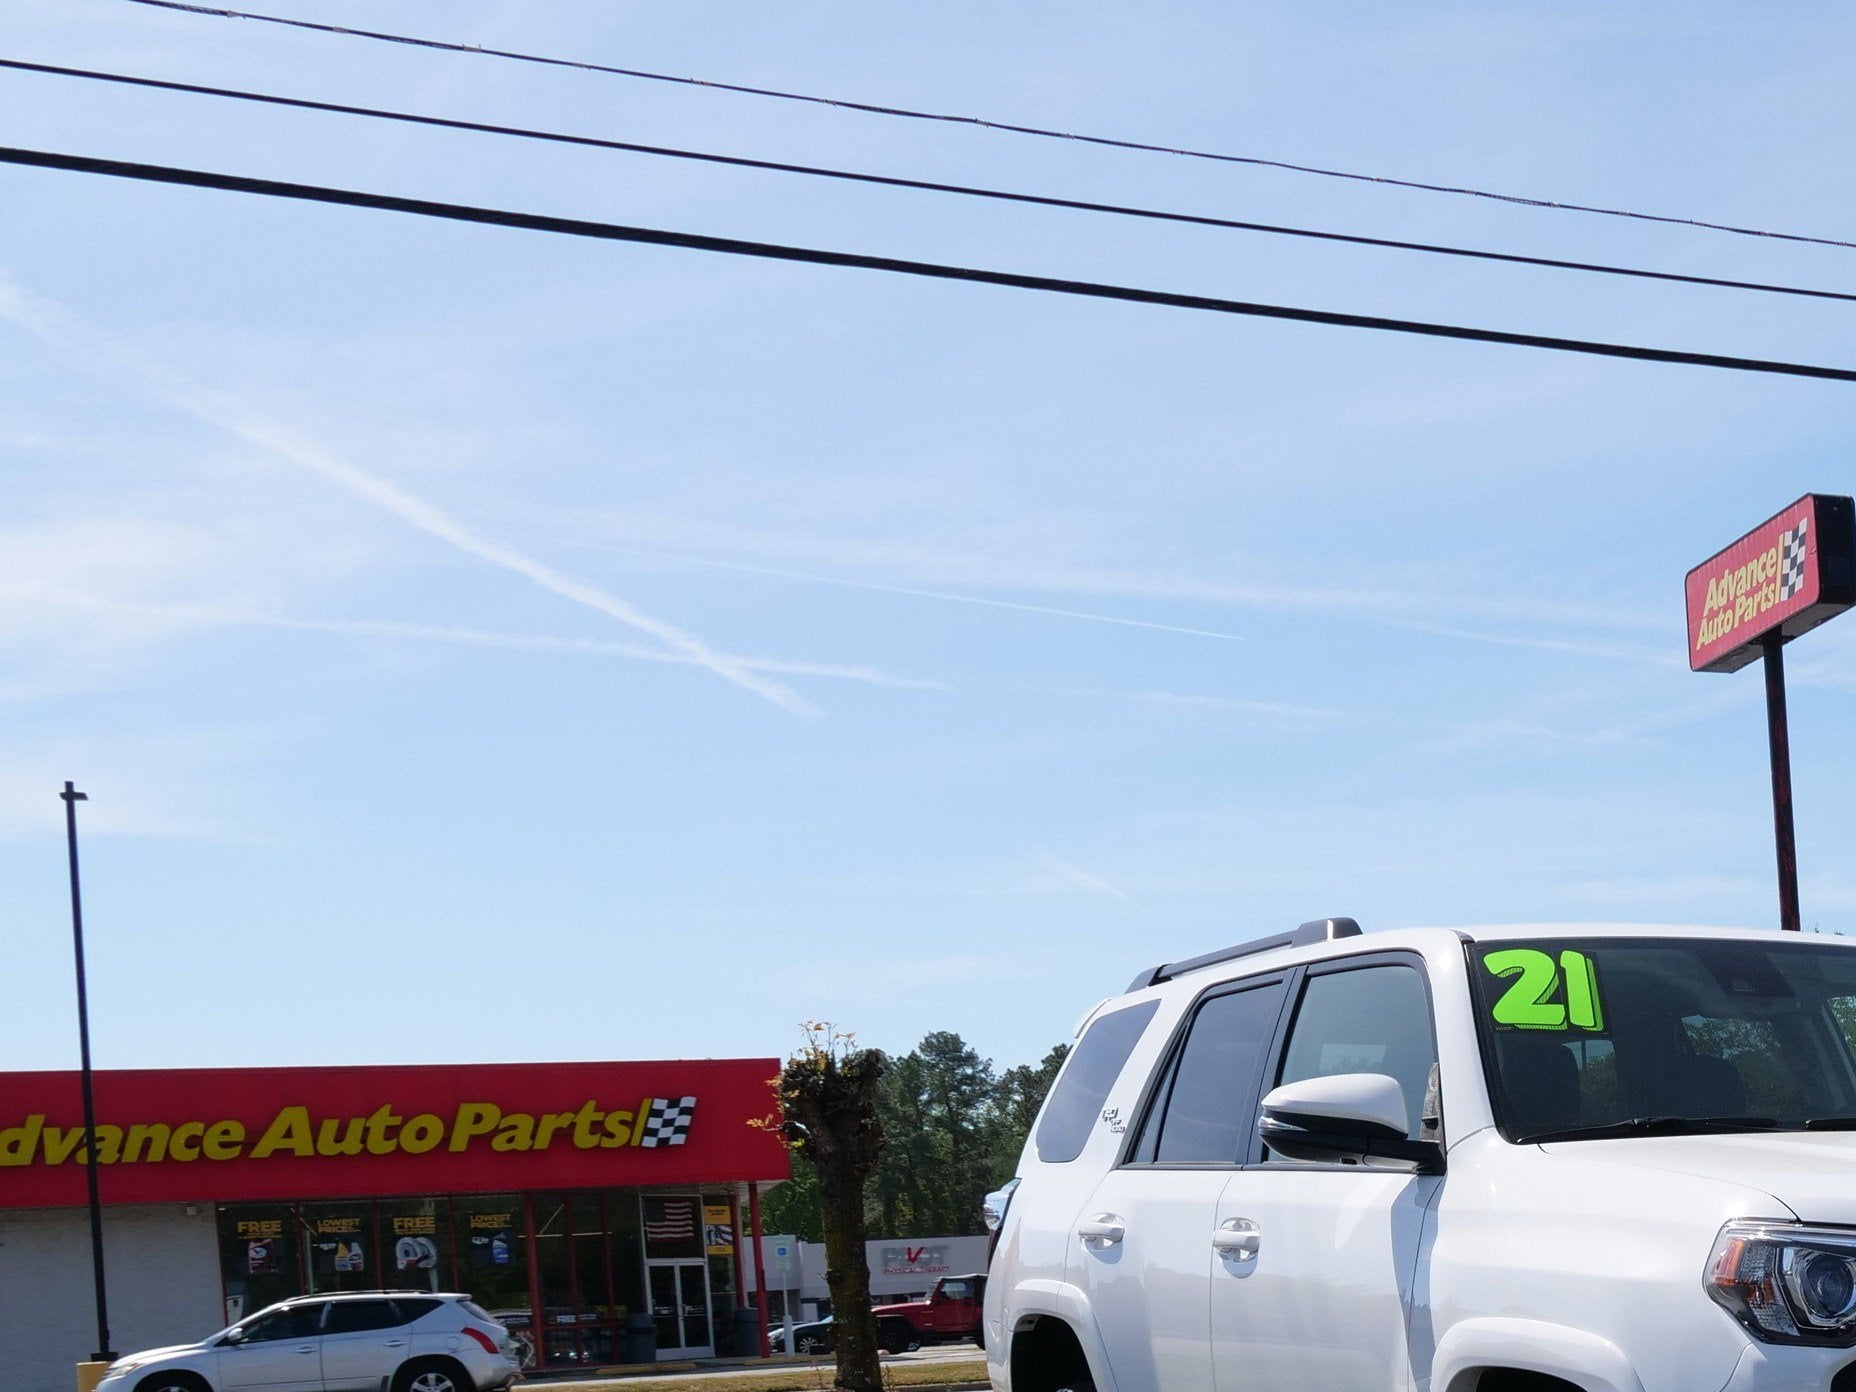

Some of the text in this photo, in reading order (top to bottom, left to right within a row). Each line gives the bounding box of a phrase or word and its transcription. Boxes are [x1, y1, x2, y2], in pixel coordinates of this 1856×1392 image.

[1696, 580, 1776, 650] Auto Parts
[1703, 547, 1777, 617] Advance
[1483, 948, 1604, 1031] 21
[0, 1101, 634, 1166] dvance Auto Parts
[237, 1220, 282, 1233] FREE
[392, 1216, 437, 1229] FREE
